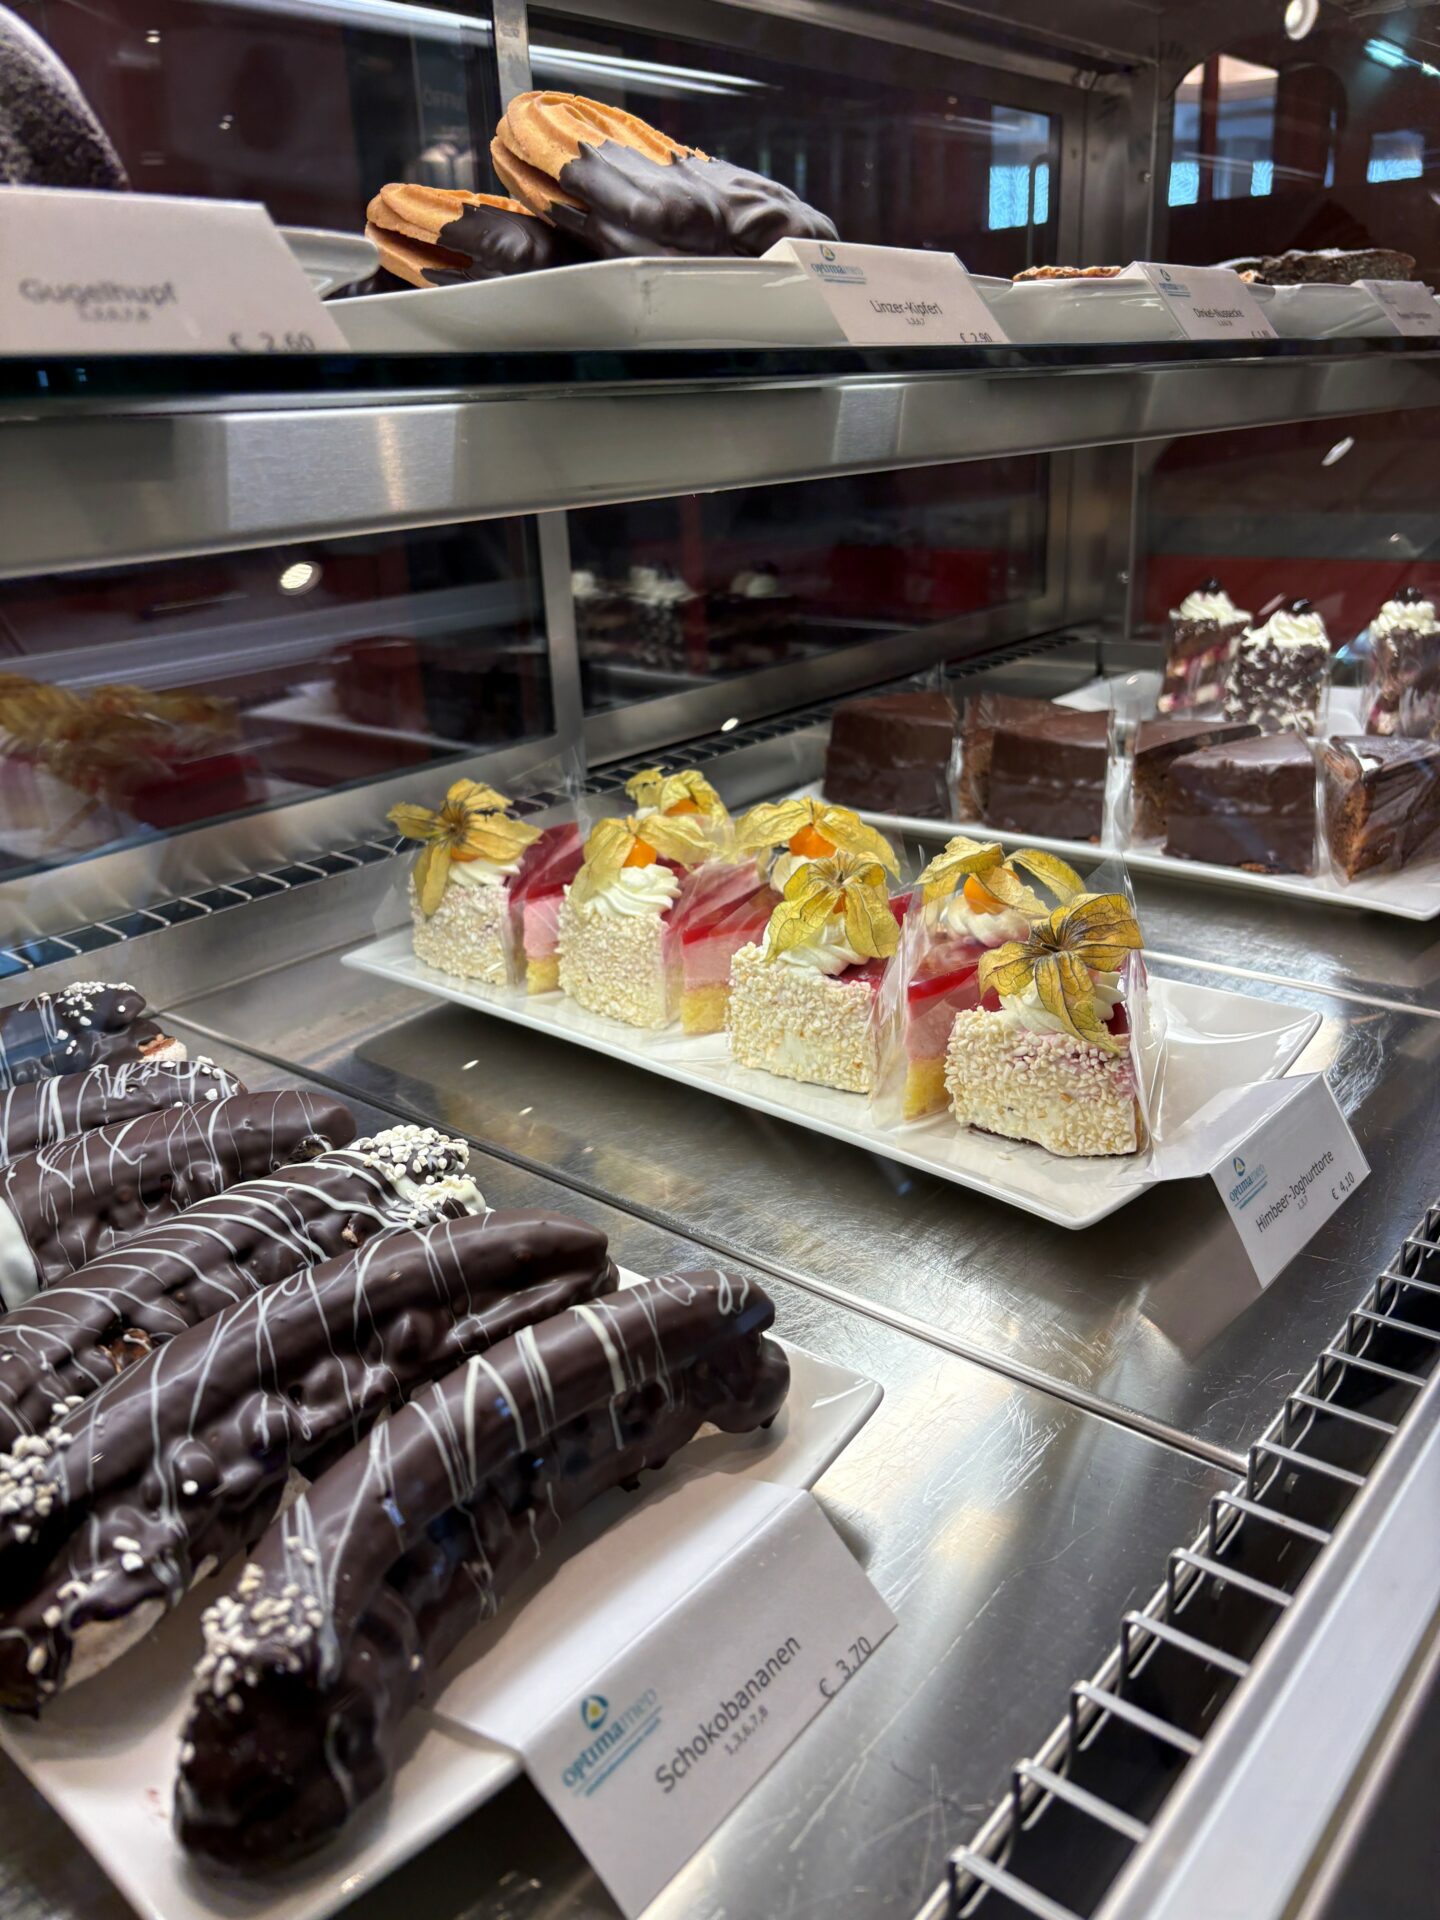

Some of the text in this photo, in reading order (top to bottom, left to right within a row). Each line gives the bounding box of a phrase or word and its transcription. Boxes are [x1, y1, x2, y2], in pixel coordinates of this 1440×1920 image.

[18, 278, 177, 307] Gugelhupf
[869, 299, 943, 317] Linzer-Kipferl
[1256, 1150, 1335, 1233] Himbeer-Joghurttorte
[1331, 1171, 1356, 1201] € 4,10
[655, 1634, 802, 1794] Schokobananen
